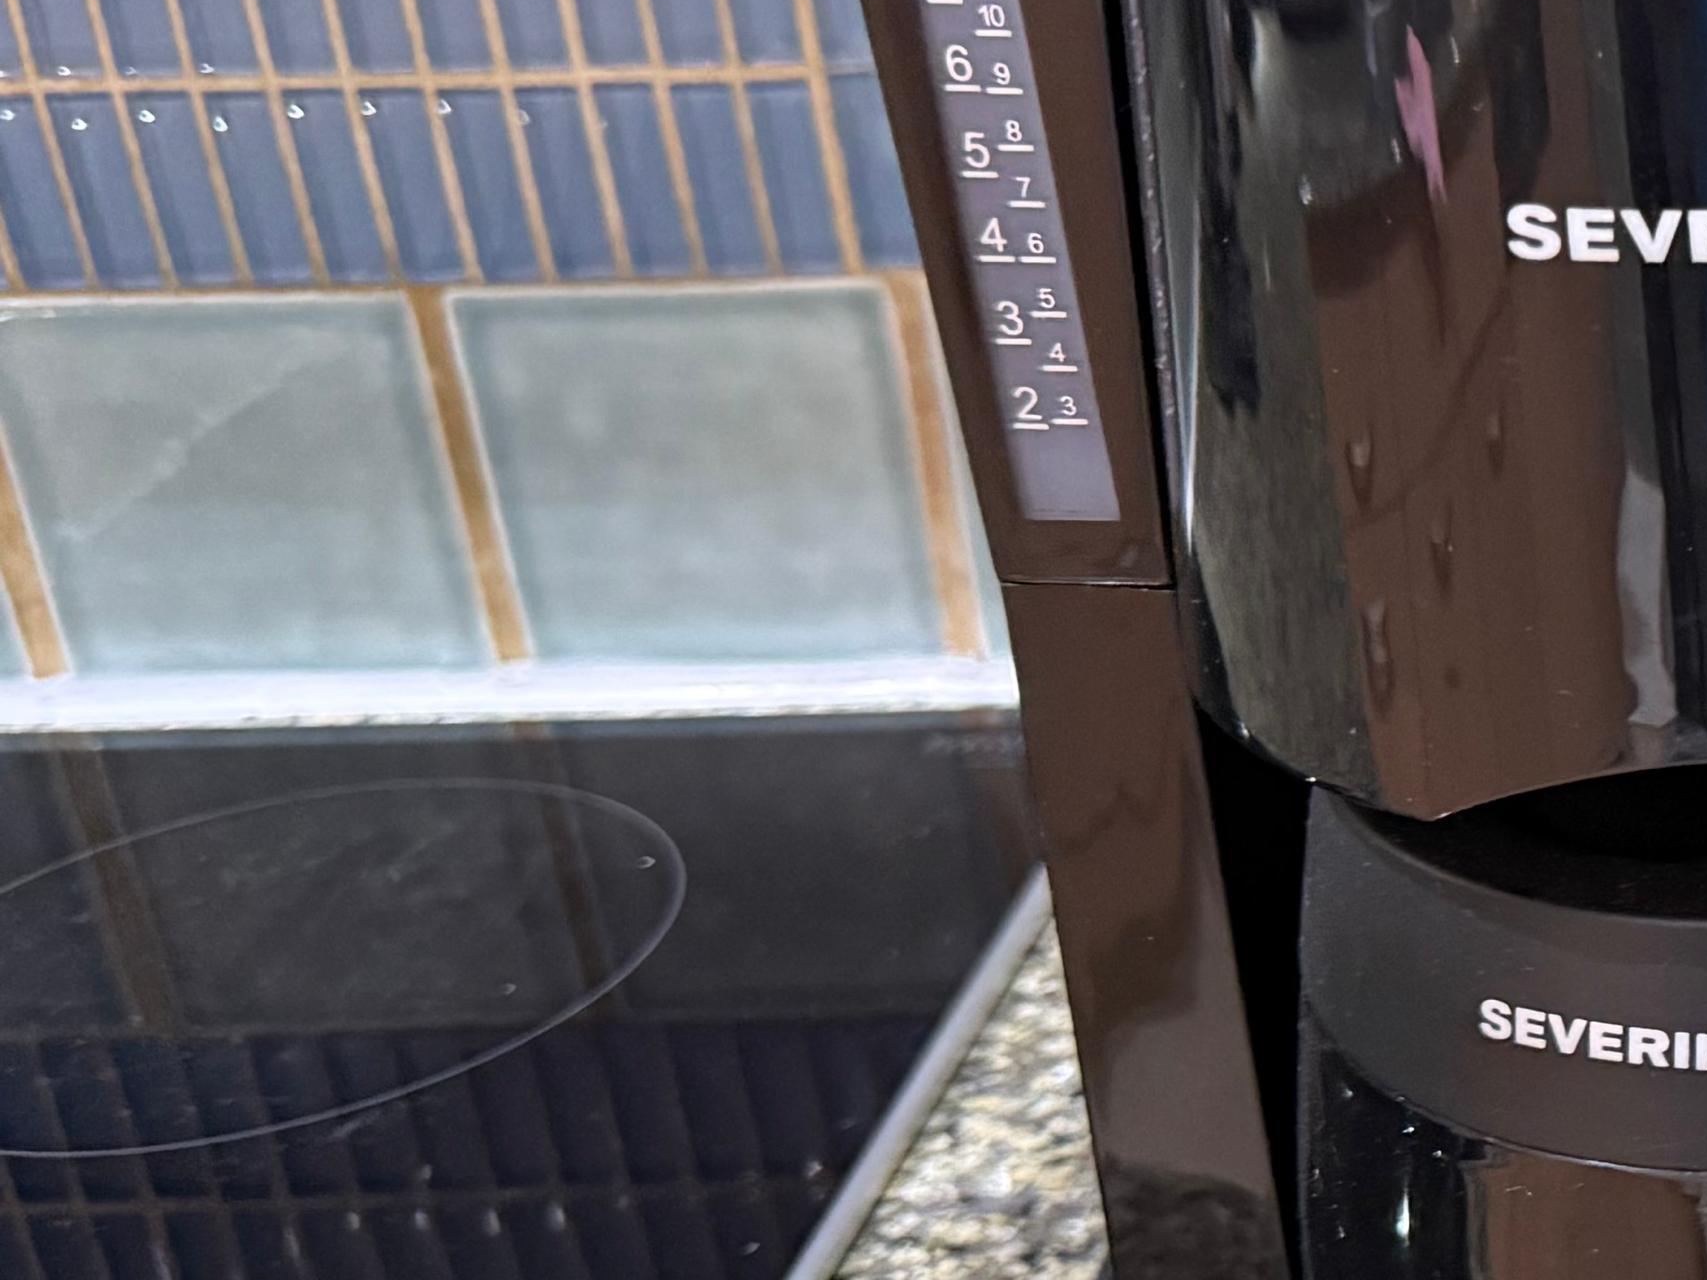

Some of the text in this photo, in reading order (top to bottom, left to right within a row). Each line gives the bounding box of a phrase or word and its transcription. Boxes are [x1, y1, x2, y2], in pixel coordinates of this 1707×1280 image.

[977, 4, 1006, 28] 10
[944, 44, 1011, 85] 6 9
[963, 119, 1023, 168] 5 8
[1014, 176, 1032, 198] 7
[979, 217, 1045, 254] 4 6
[995, 287, 1056, 336] 3 5
[1048, 342, 1066, 362] 4
[1012, 386, 1077, 421] 2 3
